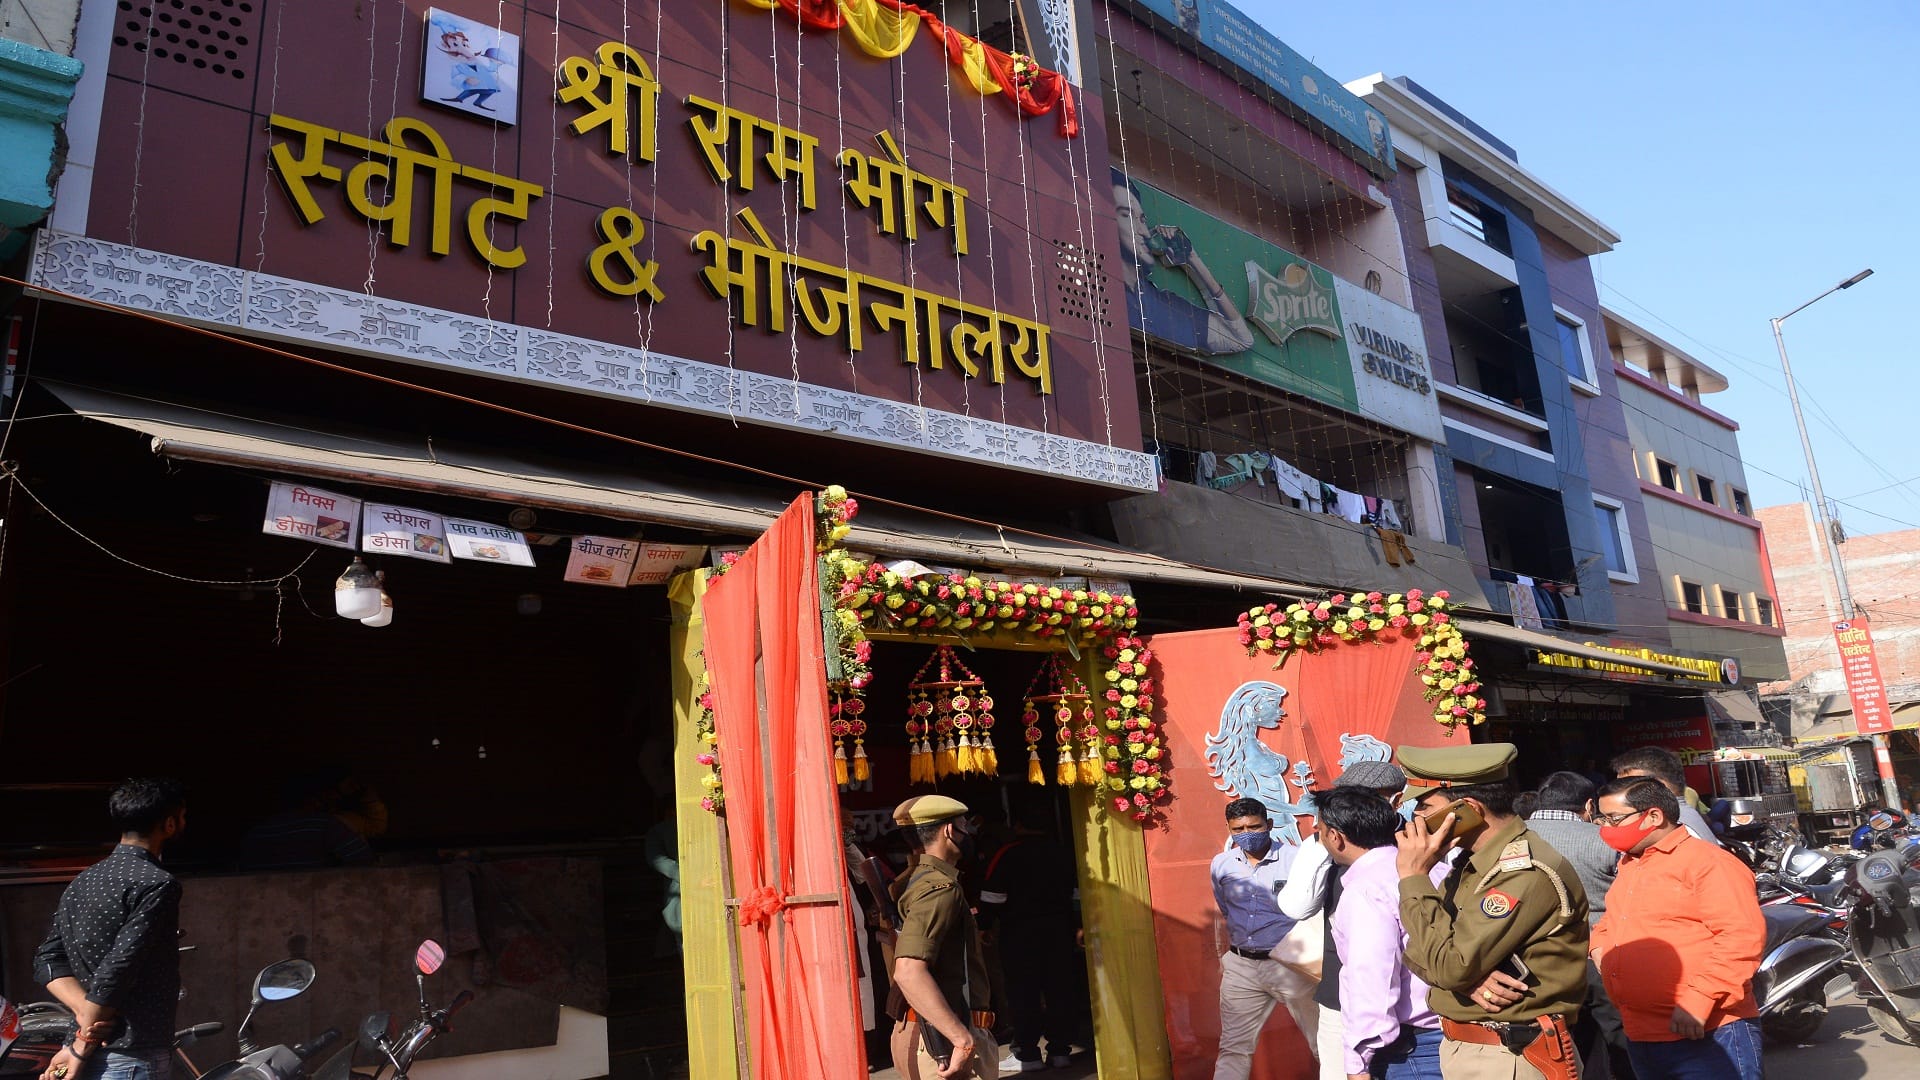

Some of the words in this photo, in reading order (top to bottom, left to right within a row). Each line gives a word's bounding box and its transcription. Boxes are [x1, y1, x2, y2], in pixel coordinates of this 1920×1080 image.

[1322, 93, 1357, 125] pepsi
[557, 41, 661, 162] श्री
[683, 93, 819, 211] राम
[837, 129, 969, 256] भोग
[267, 115, 544, 270] स्वीट
[586, 206, 666, 304] &
[690, 206, 1052, 396] भोजनालय
[92, 260, 142, 285] छोला
[146, 272, 194, 300] भटूरा
[1263, 281, 1331, 329] Sprite
[359, 310, 423, 342] डोसा
[1350, 322, 1427, 373] VIRINDER
[594, 360, 631, 380] पाव
[1361, 352, 1432, 396] SWEETS
[291, 487, 337, 511] मिक्स
[275, 515, 316, 537] डोसा
[381, 508, 432, 530] स्पेशल
[450, 523, 478, 536] पाव
[481, 525, 518, 541] भाजी
[370, 531, 411, 550] डोसा
[605, 543, 632, 559] बर्गर
[646, 548, 685, 562] समोसा
